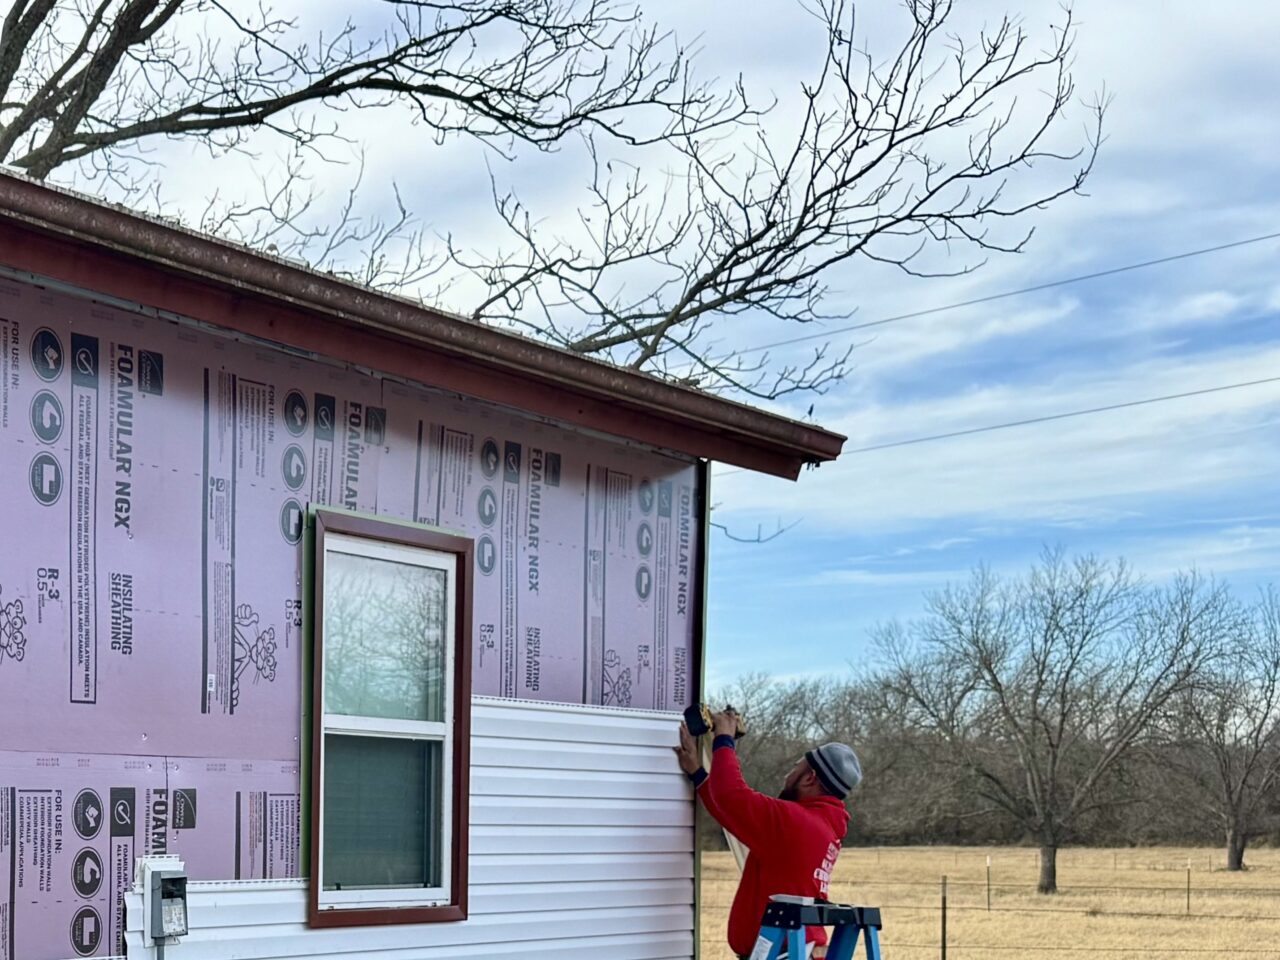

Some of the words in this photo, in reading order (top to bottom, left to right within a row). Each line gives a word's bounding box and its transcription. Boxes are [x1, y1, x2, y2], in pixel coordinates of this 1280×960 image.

[11, 320, 19, 344] FOR
[11, 346, 19, 370] USE
[10, 373, 19, 389] IN:
[37, 567, 48, 594] 0.5
[47, 567, 59, 601] R-3
[110, 573, 121, 650] SHEATHING
[121, 574, 132, 655] INSULATING
[285, 598, 294, 623] 0.5
[293, 597, 303, 630] R-3
[485, 623, 494, 648] R-3
[525, 626, 534, 690] SHEATHING
[531, 627, 540, 694] INSULATING
[54, 789, 62, 811] FOR
[54, 814, 62, 836] USE
[54, 838, 62, 854] IN:
